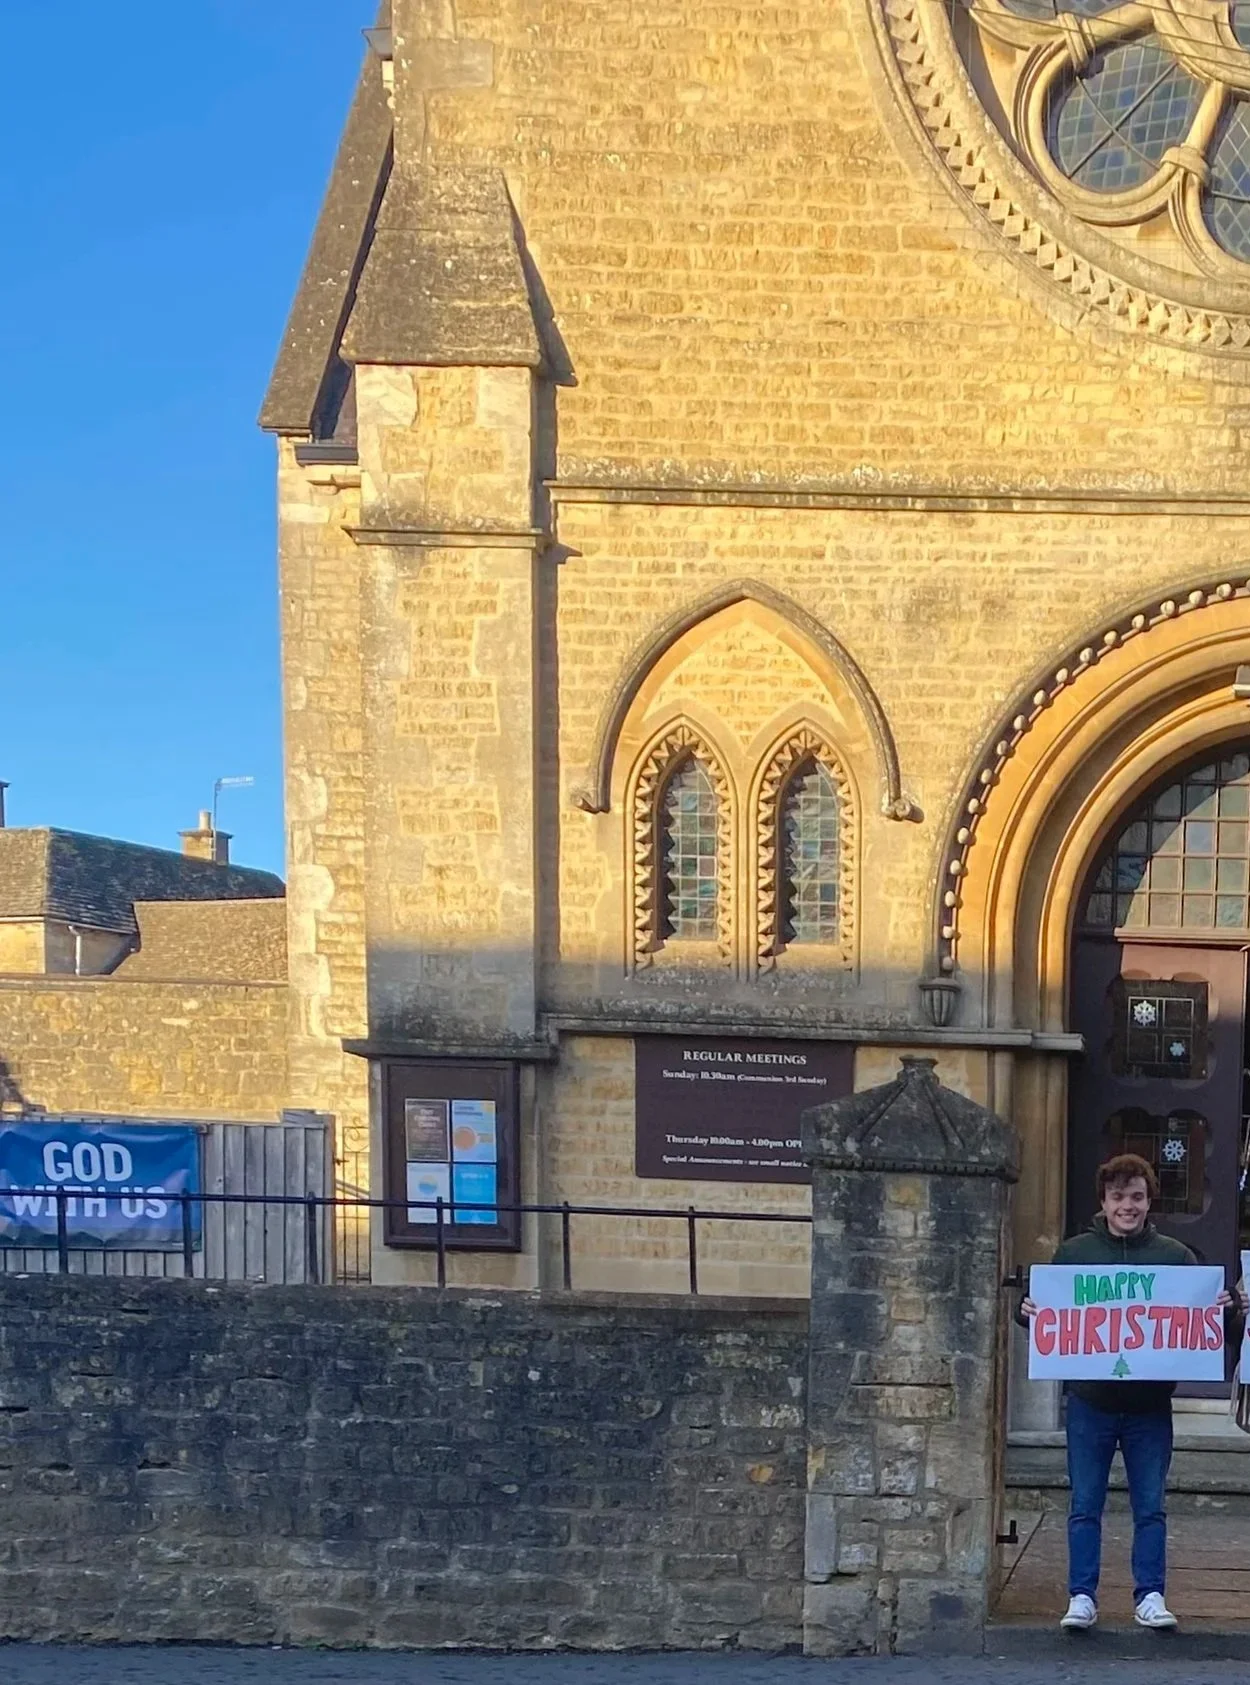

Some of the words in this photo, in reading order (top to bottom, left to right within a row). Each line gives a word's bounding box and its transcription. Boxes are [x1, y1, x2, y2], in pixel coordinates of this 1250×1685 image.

[683, 1051, 742, 1062] REGULAR
[745, 1053, 807, 1065] MEETINGS
[662, 1070, 698, 1081] Sunday:
[700, 1071, 736, 1081] 10.30am
[797, 1076, 827, 1085] Sunday)
[665, 1134, 709, 1146] Thursday
[710, 1136, 744, 1146] 10.00am
[751, 1138, 784, 1149] 4.00pm
[43, 1141, 133, 1182] GOD
[10, 1185, 107, 1218] WITH
[121, 1186, 168, 1219] US
[1074, 1272, 1157, 1305] HAPPY
[1035, 1305, 1223, 1356] CHRISTMAS
